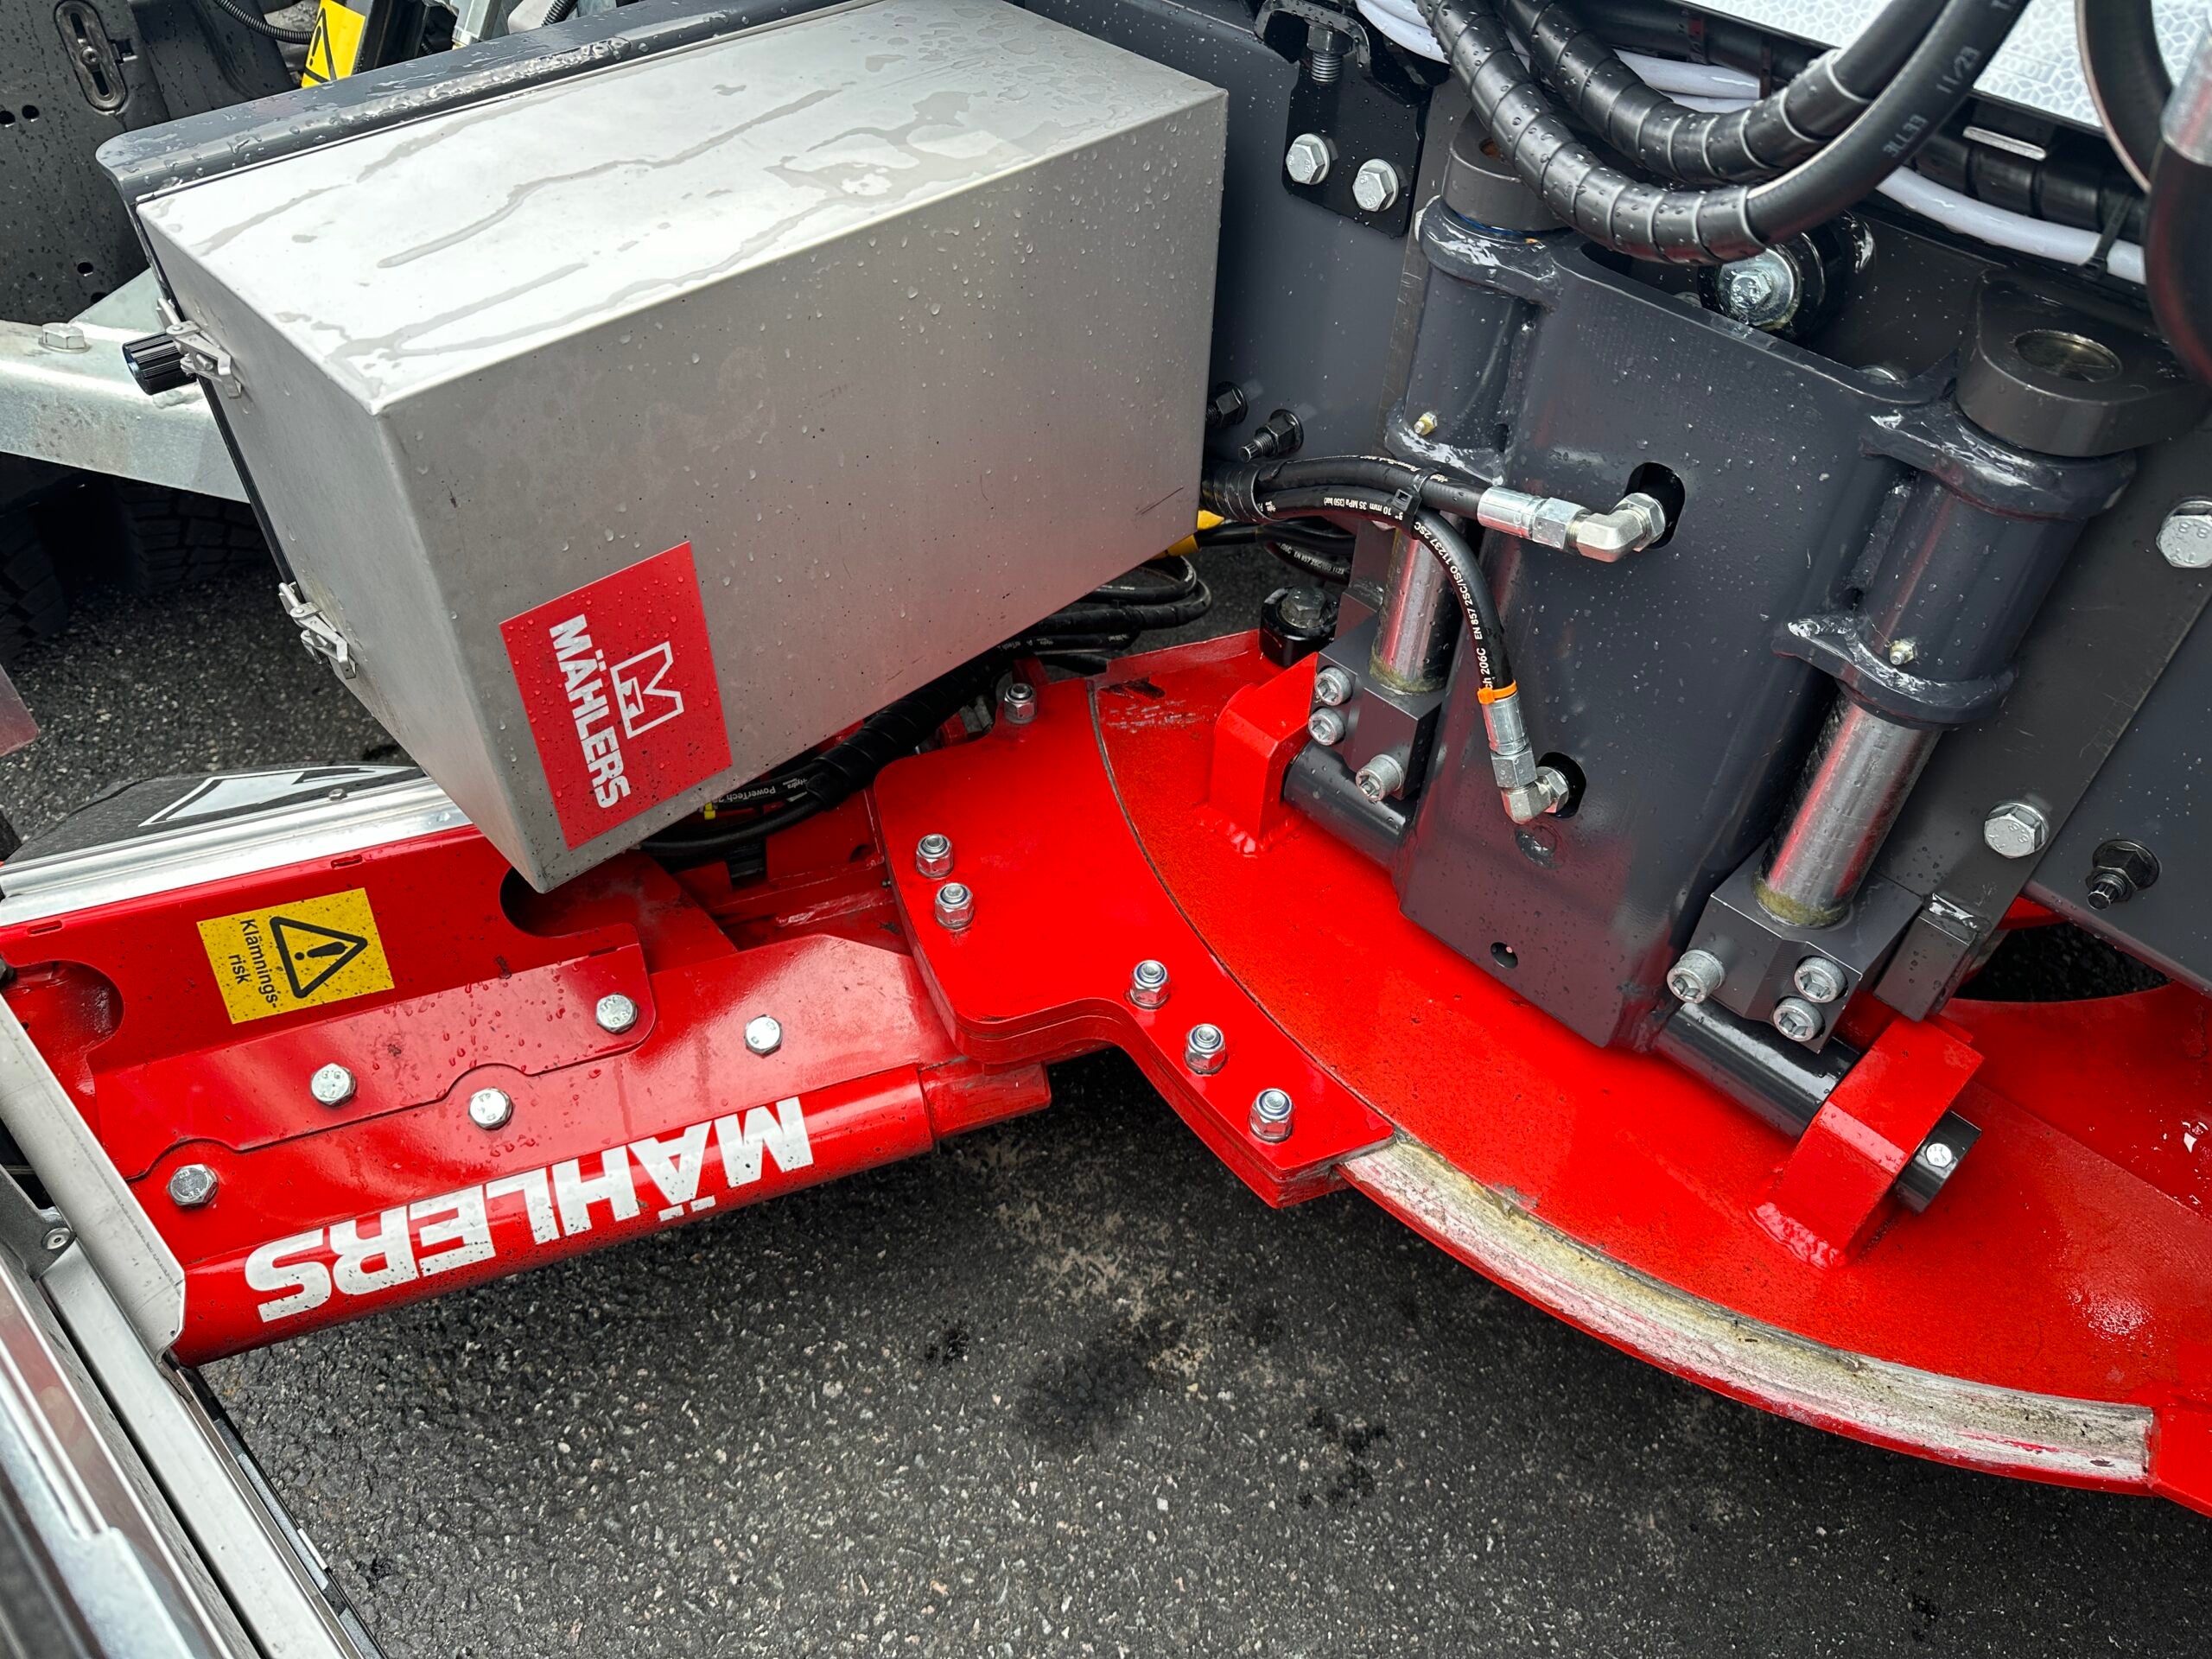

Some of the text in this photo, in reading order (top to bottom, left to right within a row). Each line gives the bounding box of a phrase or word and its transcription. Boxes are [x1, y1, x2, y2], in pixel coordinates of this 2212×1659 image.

[1345, 499, 1358, 508] MPa
[1359, 500, 1367, 510] 35
[1370, 502, 1382, 512] mm
[1383, 506, 1391, 516] 10
[1414, 521, 1432, 539] 2SC
[1430, 538, 1452, 565] 11237
[1450, 565, 1472, 607] 2SC/ISO
[1467, 608, 1479, 626] 857
[1474, 628, 1483, 640] EN
[1477, 647, 1491, 675] 206C
[549, 613, 631, 809] MÄHLERS
[727, 785, 776, 803] PowerTech
[228, 954, 251, 984] risk
[240, 918, 281, 1008] Klämnings-
[245, 1096, 814, 1323] MÄHLERS
